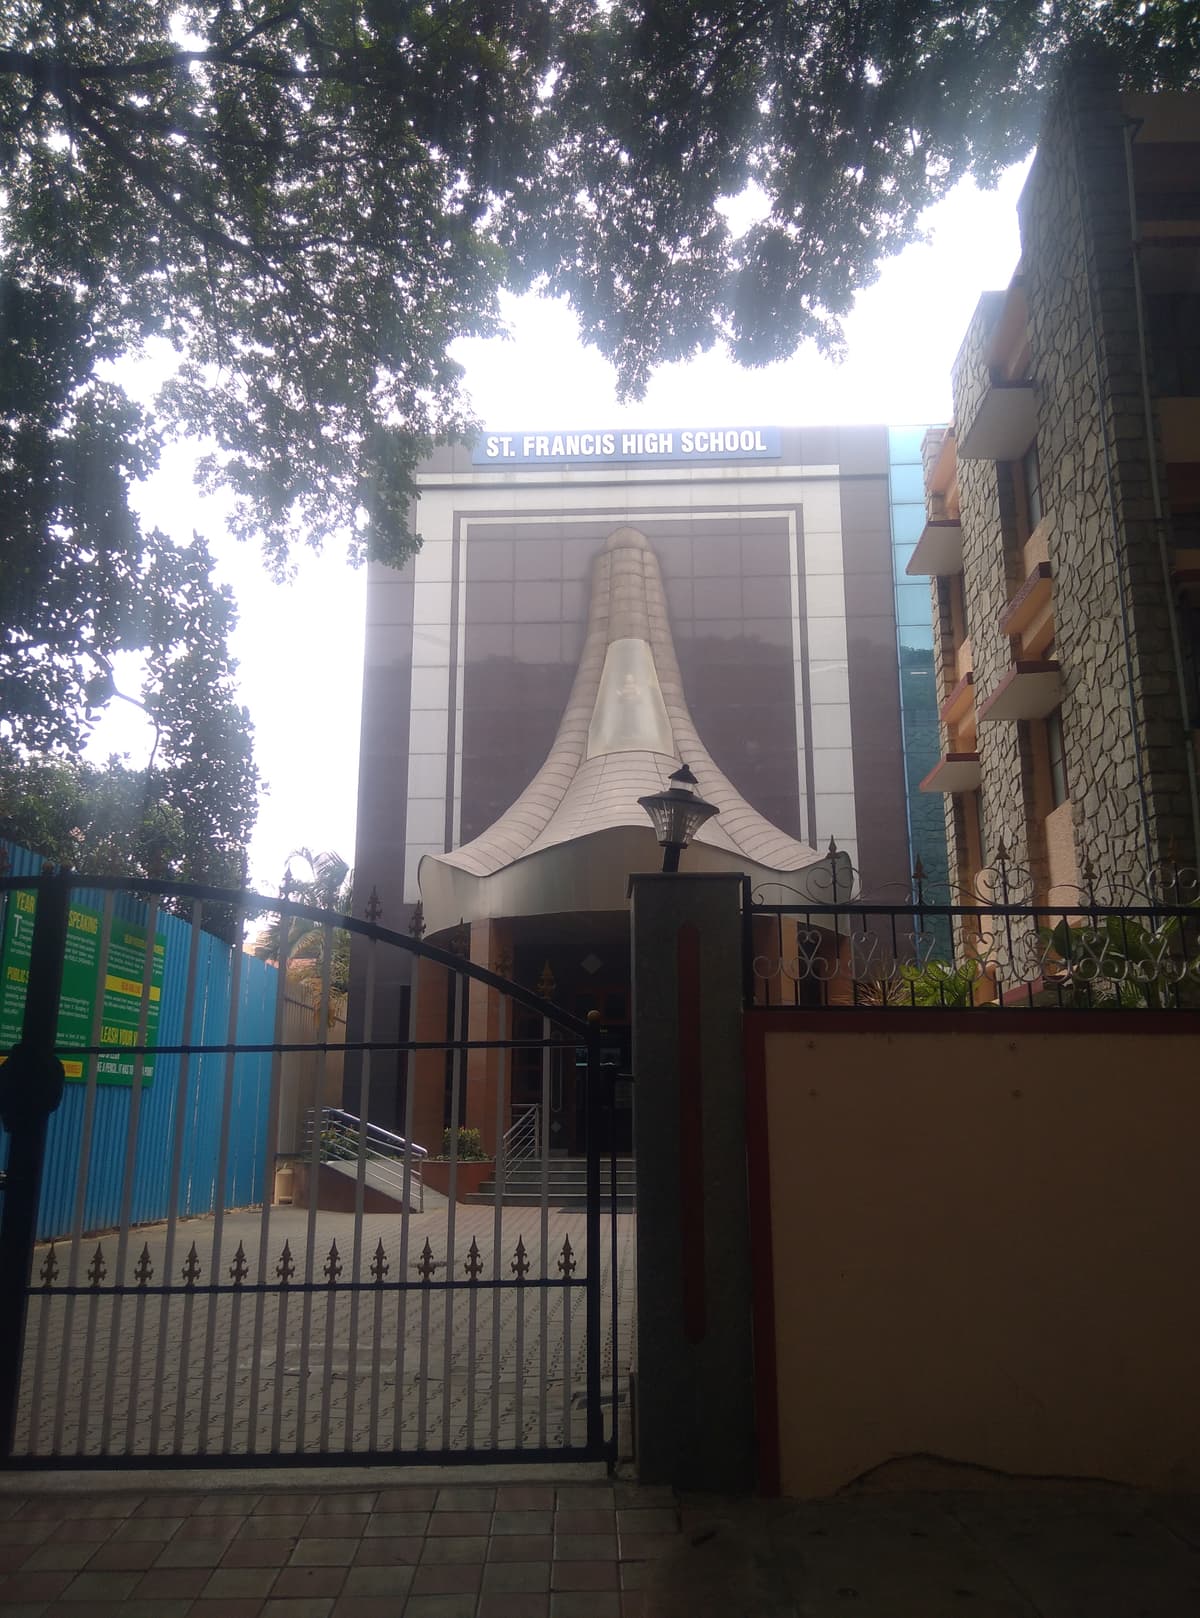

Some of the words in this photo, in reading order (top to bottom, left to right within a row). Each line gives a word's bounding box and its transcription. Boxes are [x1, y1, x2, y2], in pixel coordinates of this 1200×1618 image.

[486, 436, 515, 457] ST.
[523, 434, 615, 458] FRANCIS
[622, 432, 673, 455] HIGH
[681, 430, 767, 454] SCHOOL
